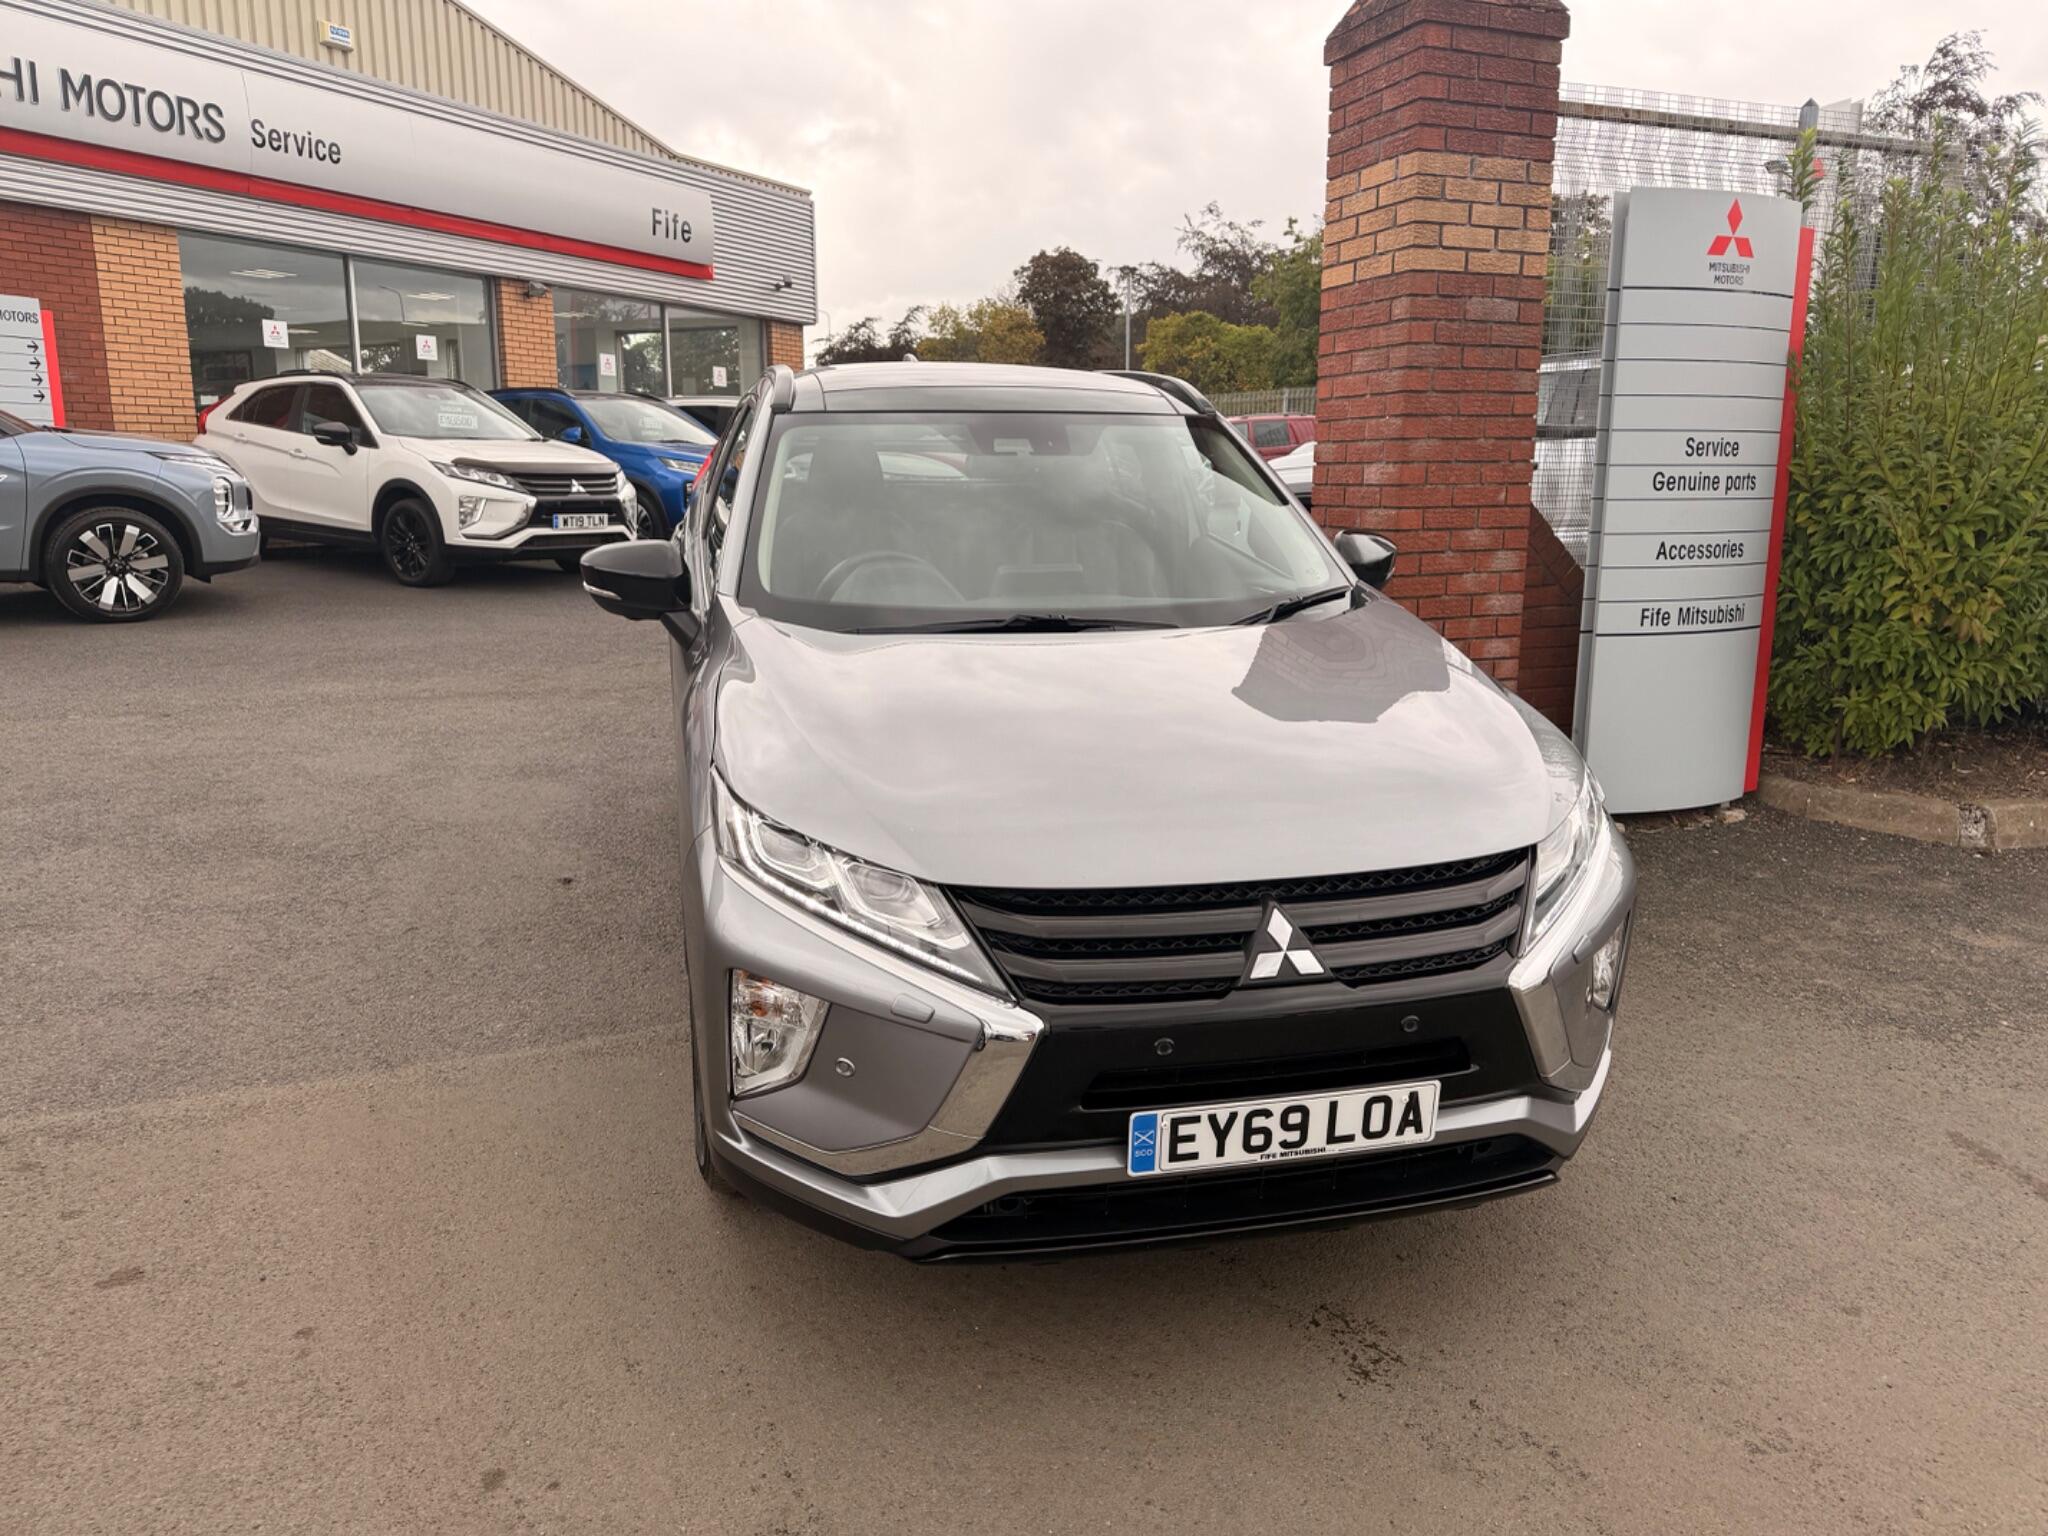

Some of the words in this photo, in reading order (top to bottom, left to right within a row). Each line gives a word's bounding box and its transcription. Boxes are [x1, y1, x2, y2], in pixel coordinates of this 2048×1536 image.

[58, 67, 226, 144] MOTORS
[250, 118, 342, 165] Service
[652, 207, 692, 243] Fife
[1708, 261, 1751, 274] MITSUBISHI
[1713, 274, 1745, 285] MOTORS
[1685, 437, 1740, 457] Service
[1652, 471, 1720, 492] Genuine
[1725, 472, 1757, 495] parts
[1655, 539, 1745, 561] Accessories
[1640, 607, 1671, 628] Fife
[1677, 603, 1746, 626] Mitsubishi
[1168, 1104, 1311, 1164] EY69
[1326, 1091, 1424, 1146] LOA
[1134, 1149, 1154, 1158] SCO
[1260, 1152, 1278, 1161] FIFE
[1279, 1147, 1326, 1159] MITSUBISHI
